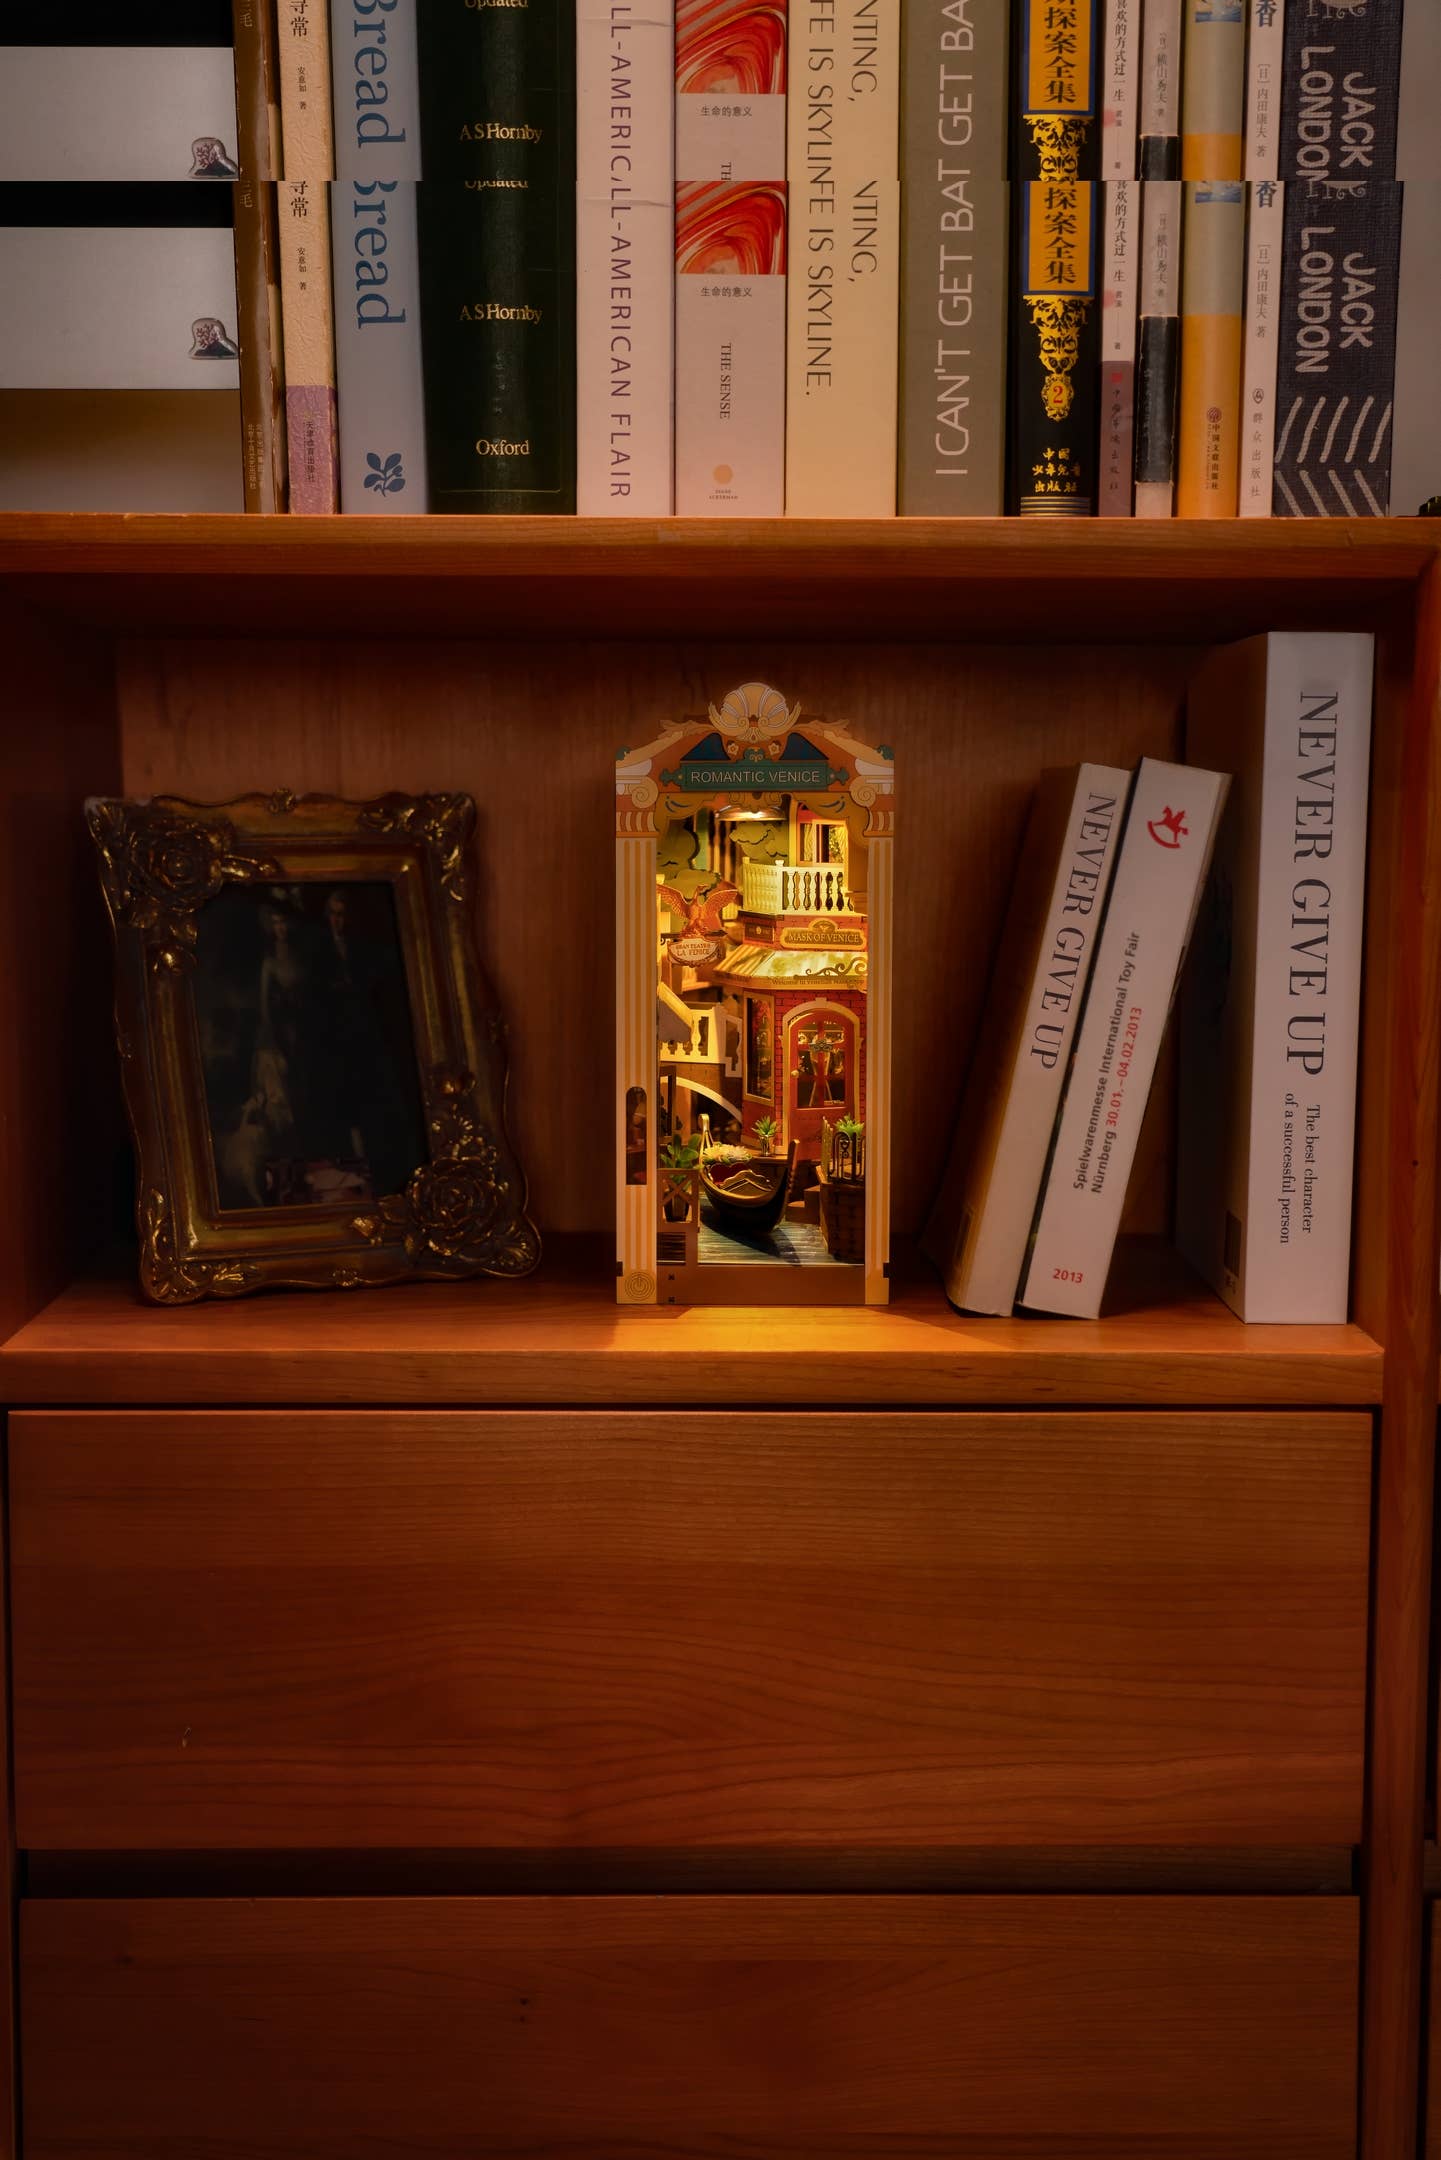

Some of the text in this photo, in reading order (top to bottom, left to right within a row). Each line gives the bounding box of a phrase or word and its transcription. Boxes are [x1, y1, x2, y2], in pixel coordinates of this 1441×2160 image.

[808, 48, 834, 71] IS
[700, 106, 752, 117] 生命的意义
[938, 64, 974, 146] GET
[1338, 71, 1377, 168] JACK
[459, 123, 544, 143] A S Hornby
[1256, 145, 1268, 158] 著
[807, 229, 834, 252] IS
[1043, 181, 1077, 284] 探案全集
[297, 247, 307, 272] 安意如
[700, 287, 752, 298] 生命的意义
[938, 244, 973, 326] GET
[1296, 225, 1336, 374] LONDON
[1339, 252, 1377, 349] JACK
[459, 304, 543, 325] A S Hornby
[806, 265, 834, 396] SKYLINE.
[1256, 326, 1268, 339] 著
[719, 342, 732, 420] THE SENSE
[934, 339, 970, 456] CAN'T
[1053, 386, 1063, 403] 2
[475, 439, 531, 456] Oxford
[610, 413, 632, 497] FLAIR
[1042, 447, 1071, 461] 中国
[1034, 480, 1078, 494] 出版社
[691, 770, 821, 783] ROMANTIC VENICE
[1286, 690, 1339, 1077] NEVER GIVE UP
[788, 932, 860, 943] MASK OF VENICE
[1030, 791, 1117, 1070] NEVER GIVE UP
[1073, 931, 1140, 1190] Spielwarenmesse International Toy Fair
[1285, 1093, 1298, 1107] of
[1091, 1130, 1117, 1193] Nürnberg
[1282, 1122, 1296, 1193] successful
[1302, 1104, 1320, 1233] The best character
[1278, 1198, 1291, 1243] person
[1052, 1268, 1083, 1283] 2013
